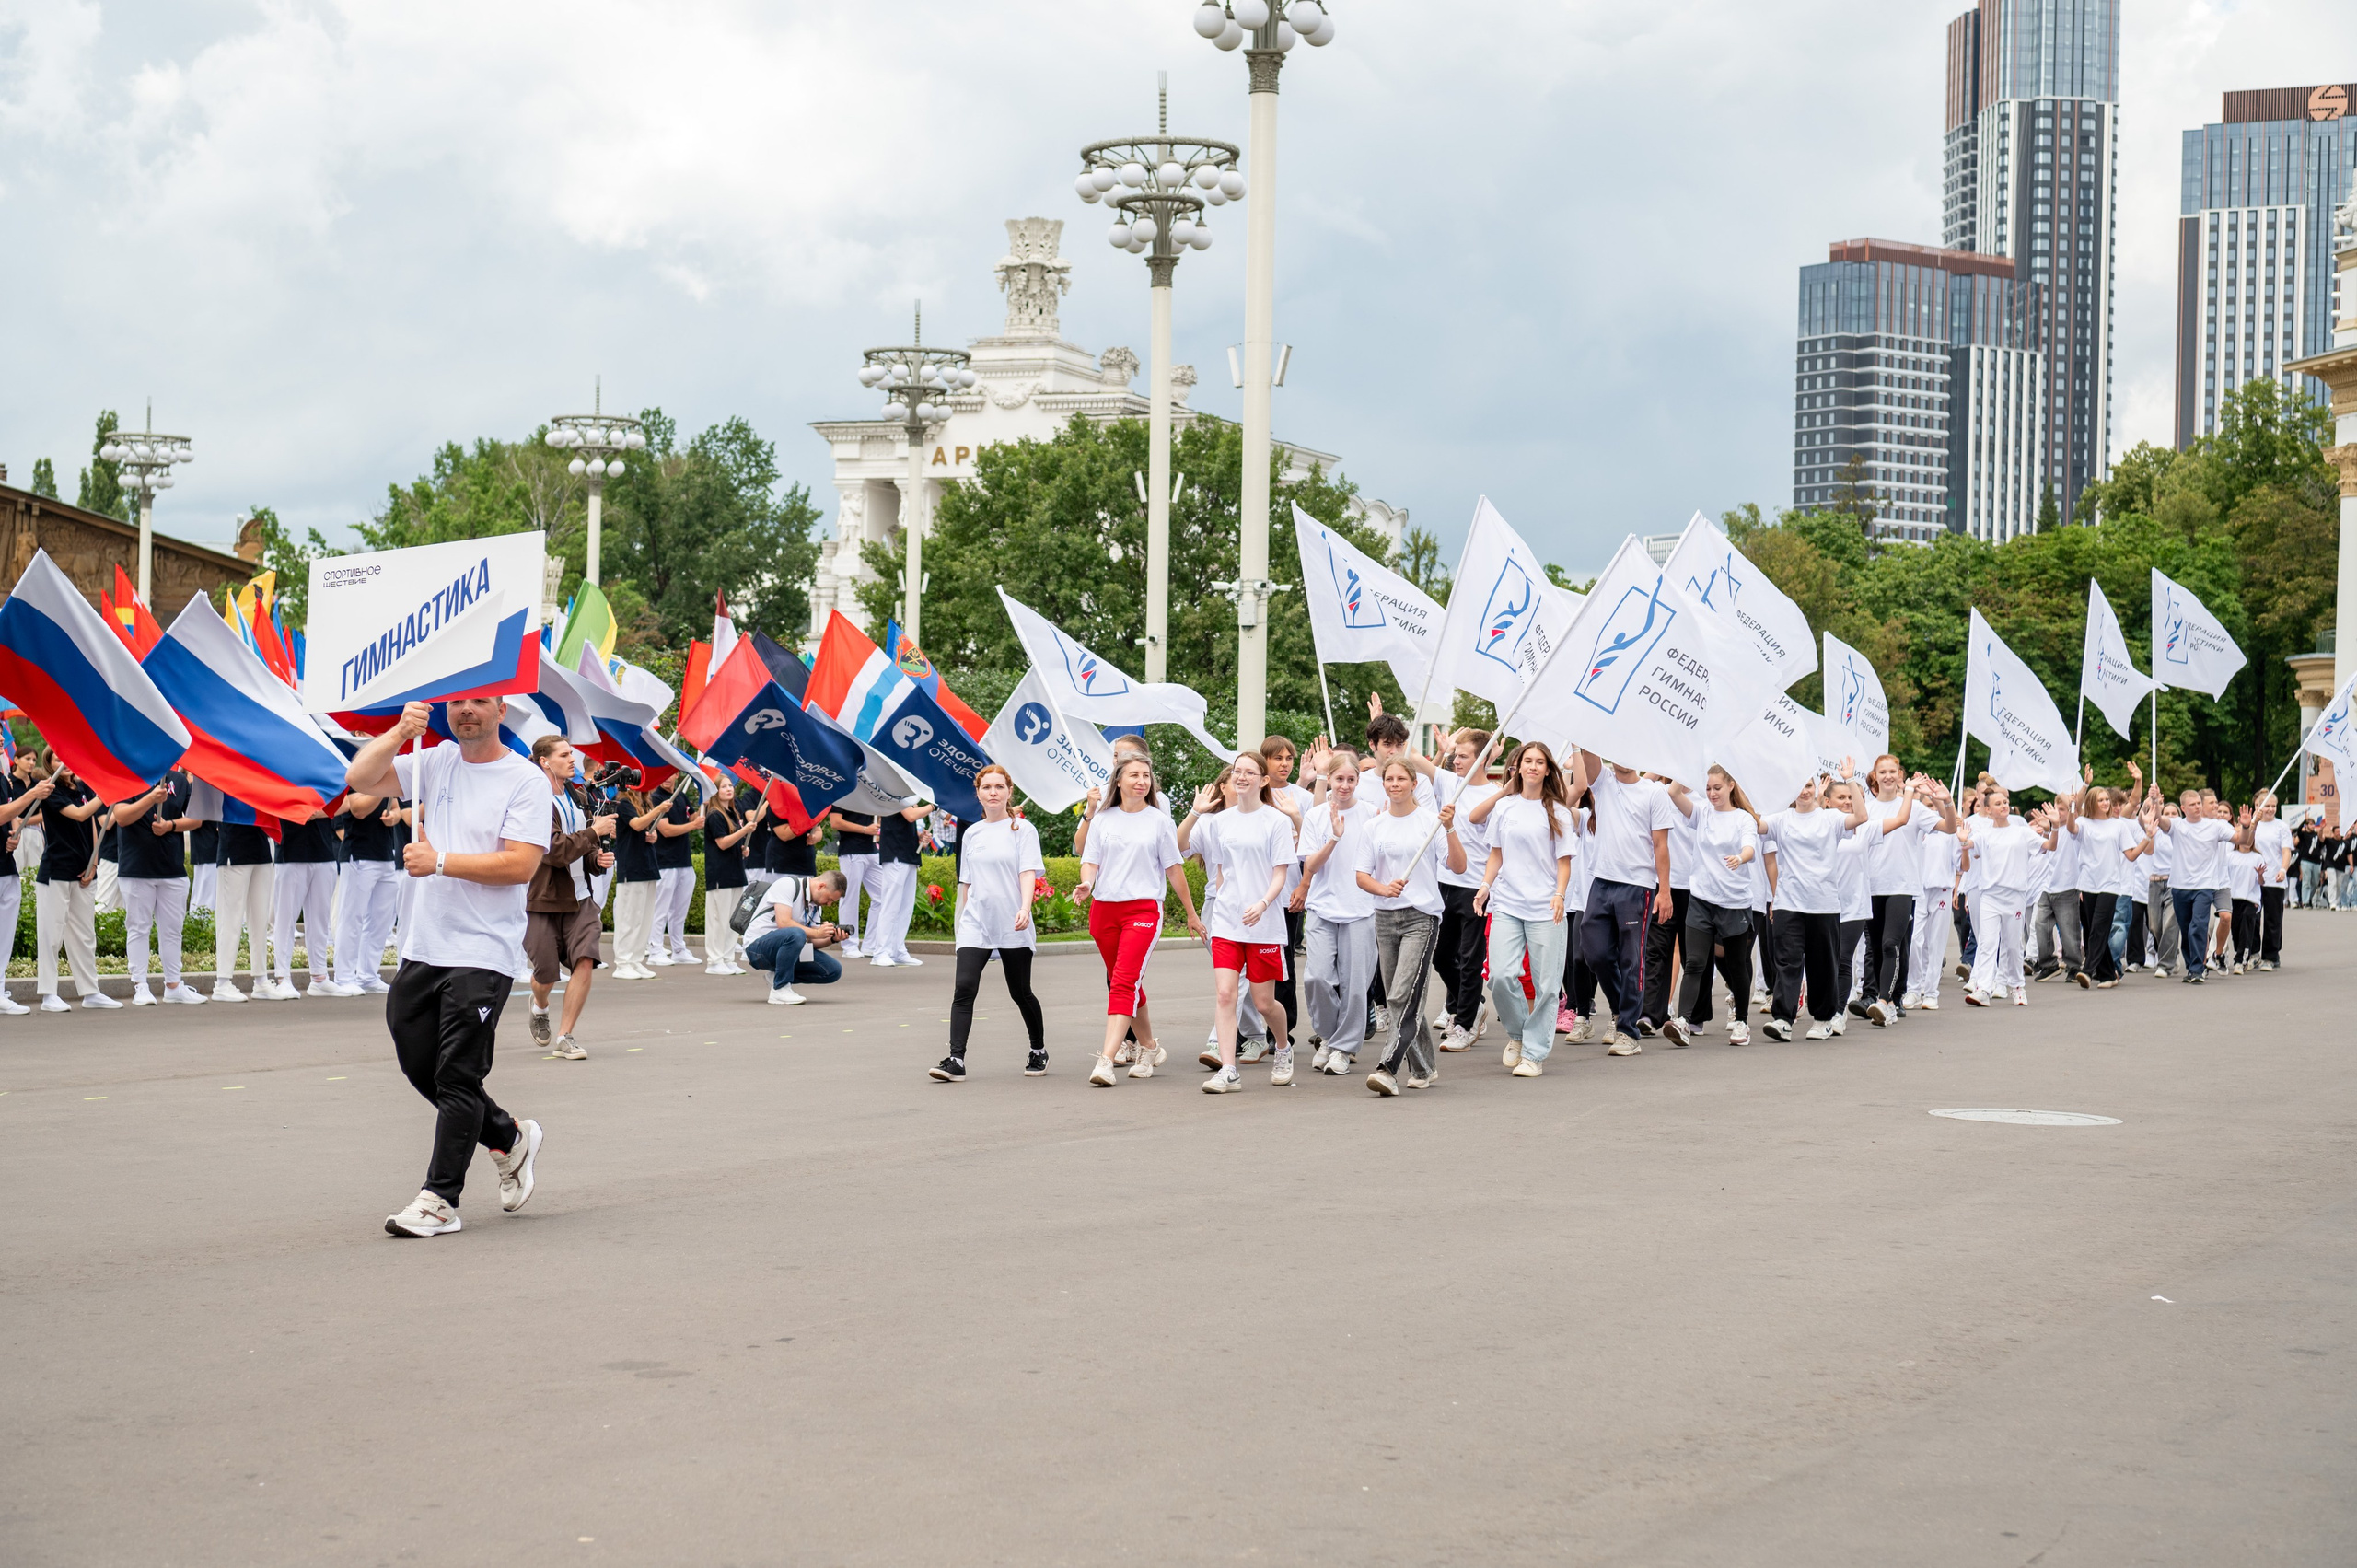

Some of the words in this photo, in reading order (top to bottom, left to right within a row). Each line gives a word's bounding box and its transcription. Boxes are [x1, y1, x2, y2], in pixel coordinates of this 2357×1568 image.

[323, 577, 367, 588] ШЕСТВИЕ
[1370, 589, 1428, 620] ЕРАЦИЯ
[341, 557, 490, 702] ГИМНАСТИКА
[1736, 610, 1786, 658] ФЕДЕРАЦИЯ
[1666, 647, 1710, 684] ФЕДЕР
[1638, 685, 1699, 730] РОССИИ
[2320, 784, 2335, 796] 30
